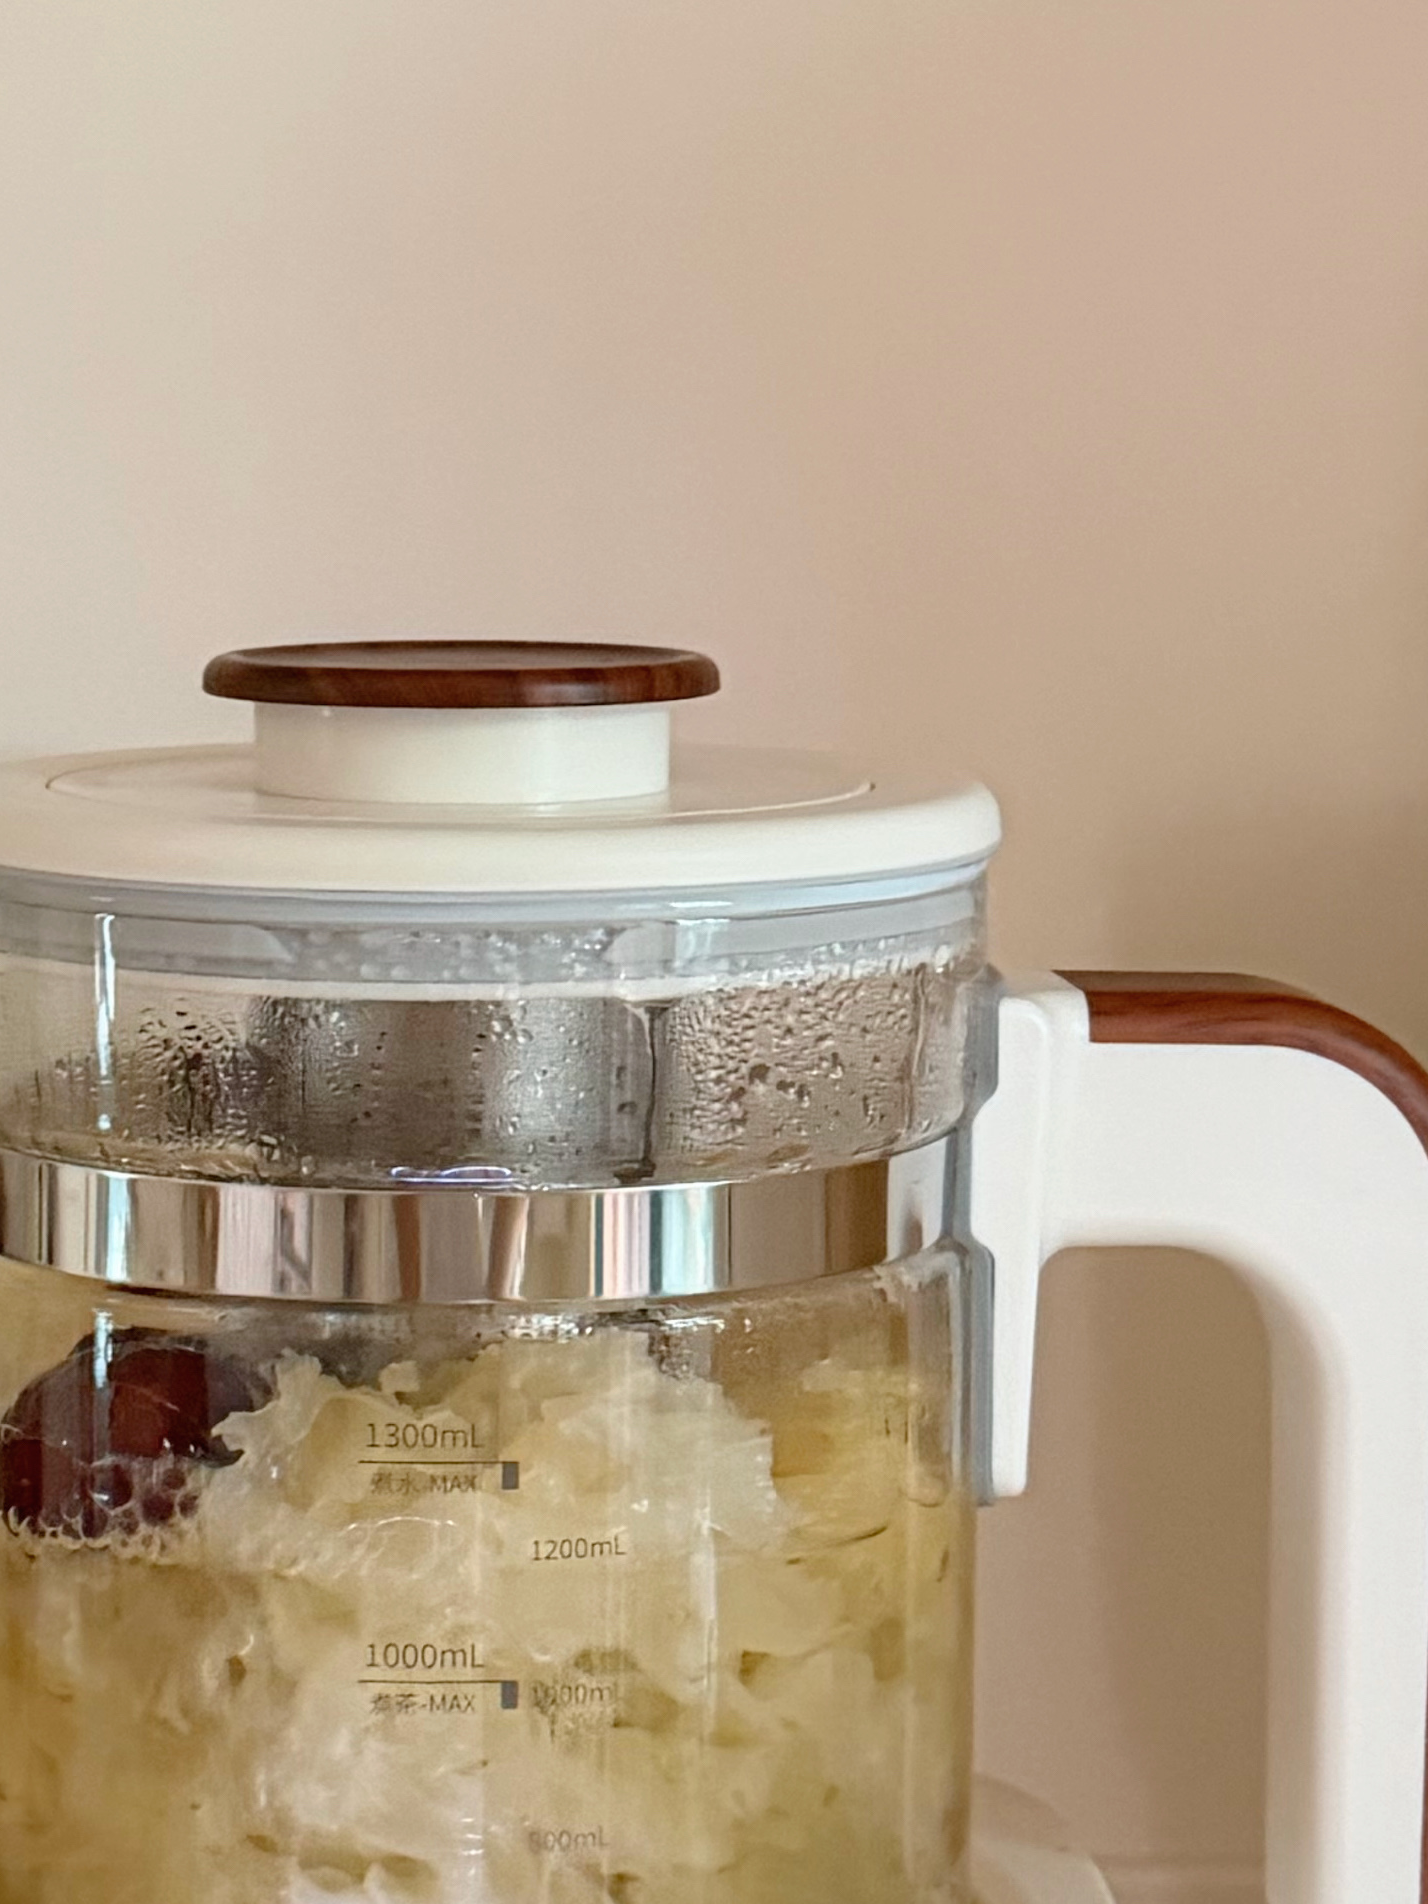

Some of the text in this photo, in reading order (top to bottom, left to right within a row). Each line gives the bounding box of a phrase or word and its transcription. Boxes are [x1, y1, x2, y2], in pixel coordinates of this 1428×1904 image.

[366, 1422, 484, 1449] 1300mL
[531, 1535, 627, 1562] 1200mL
[365, 1642, 485, 1669] 1000mL
